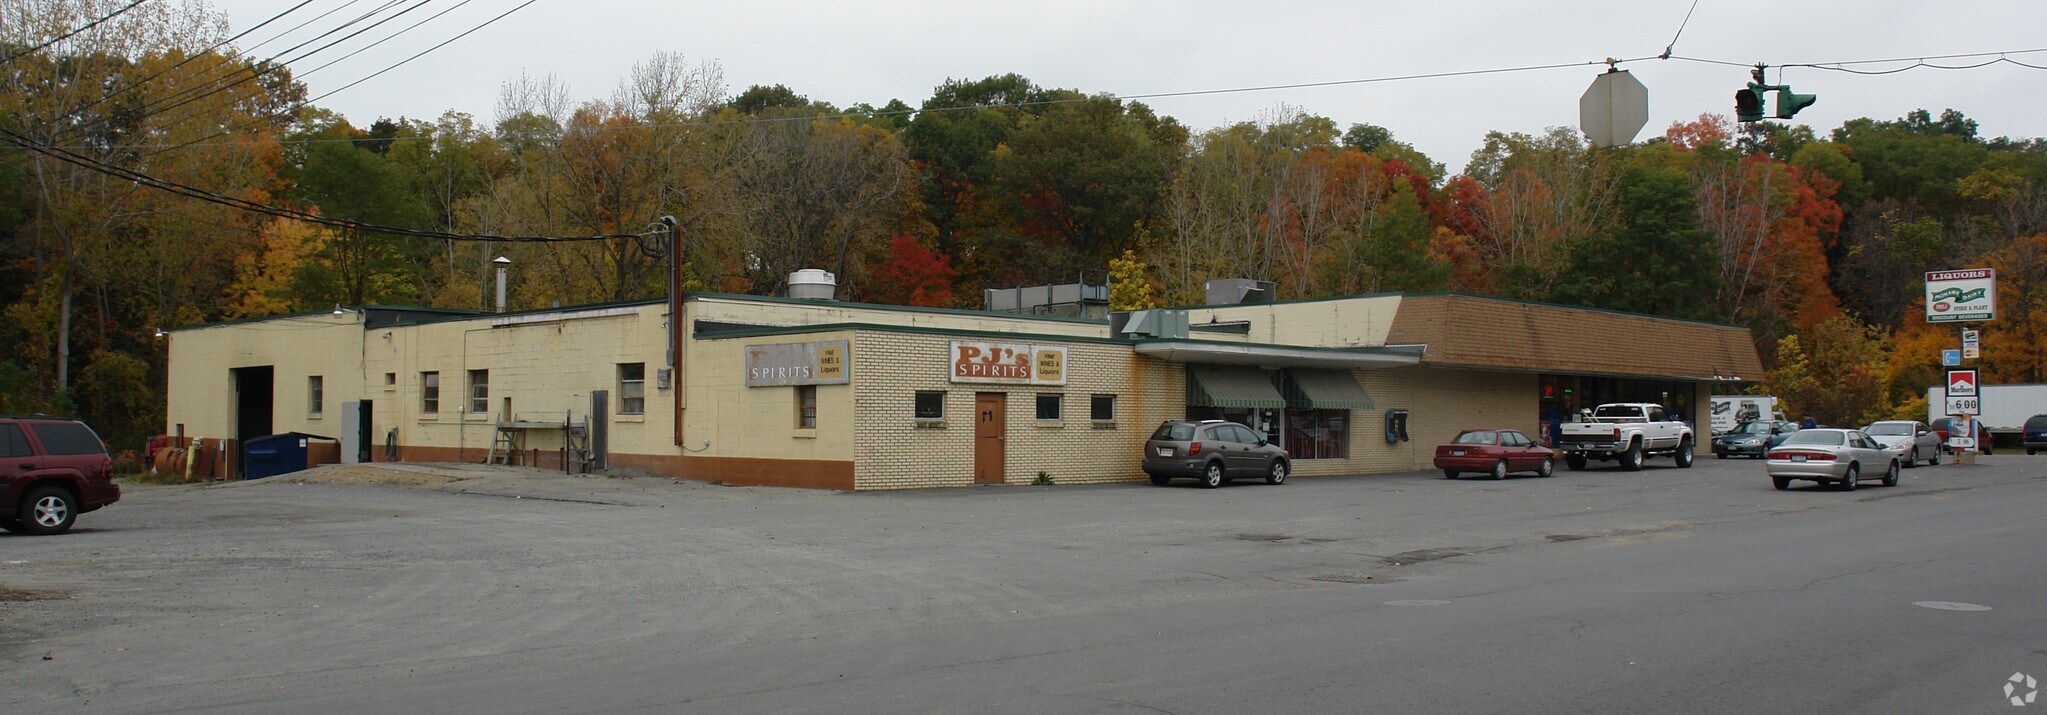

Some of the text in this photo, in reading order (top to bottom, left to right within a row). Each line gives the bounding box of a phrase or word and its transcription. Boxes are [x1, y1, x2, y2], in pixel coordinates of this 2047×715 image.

[1932, 271, 1985, 280] LIQUORS
[1935, 290, 1982, 300] MOHAWK DAIRY
[821, 356, 835, 364] WINES
[957, 346, 1029, 365] PJ's
[752, 366, 809, 379] SPIRITS
[959, 363, 1027, 377] SPIRITS
[1950, 385, 1974, 393] Marlboro
